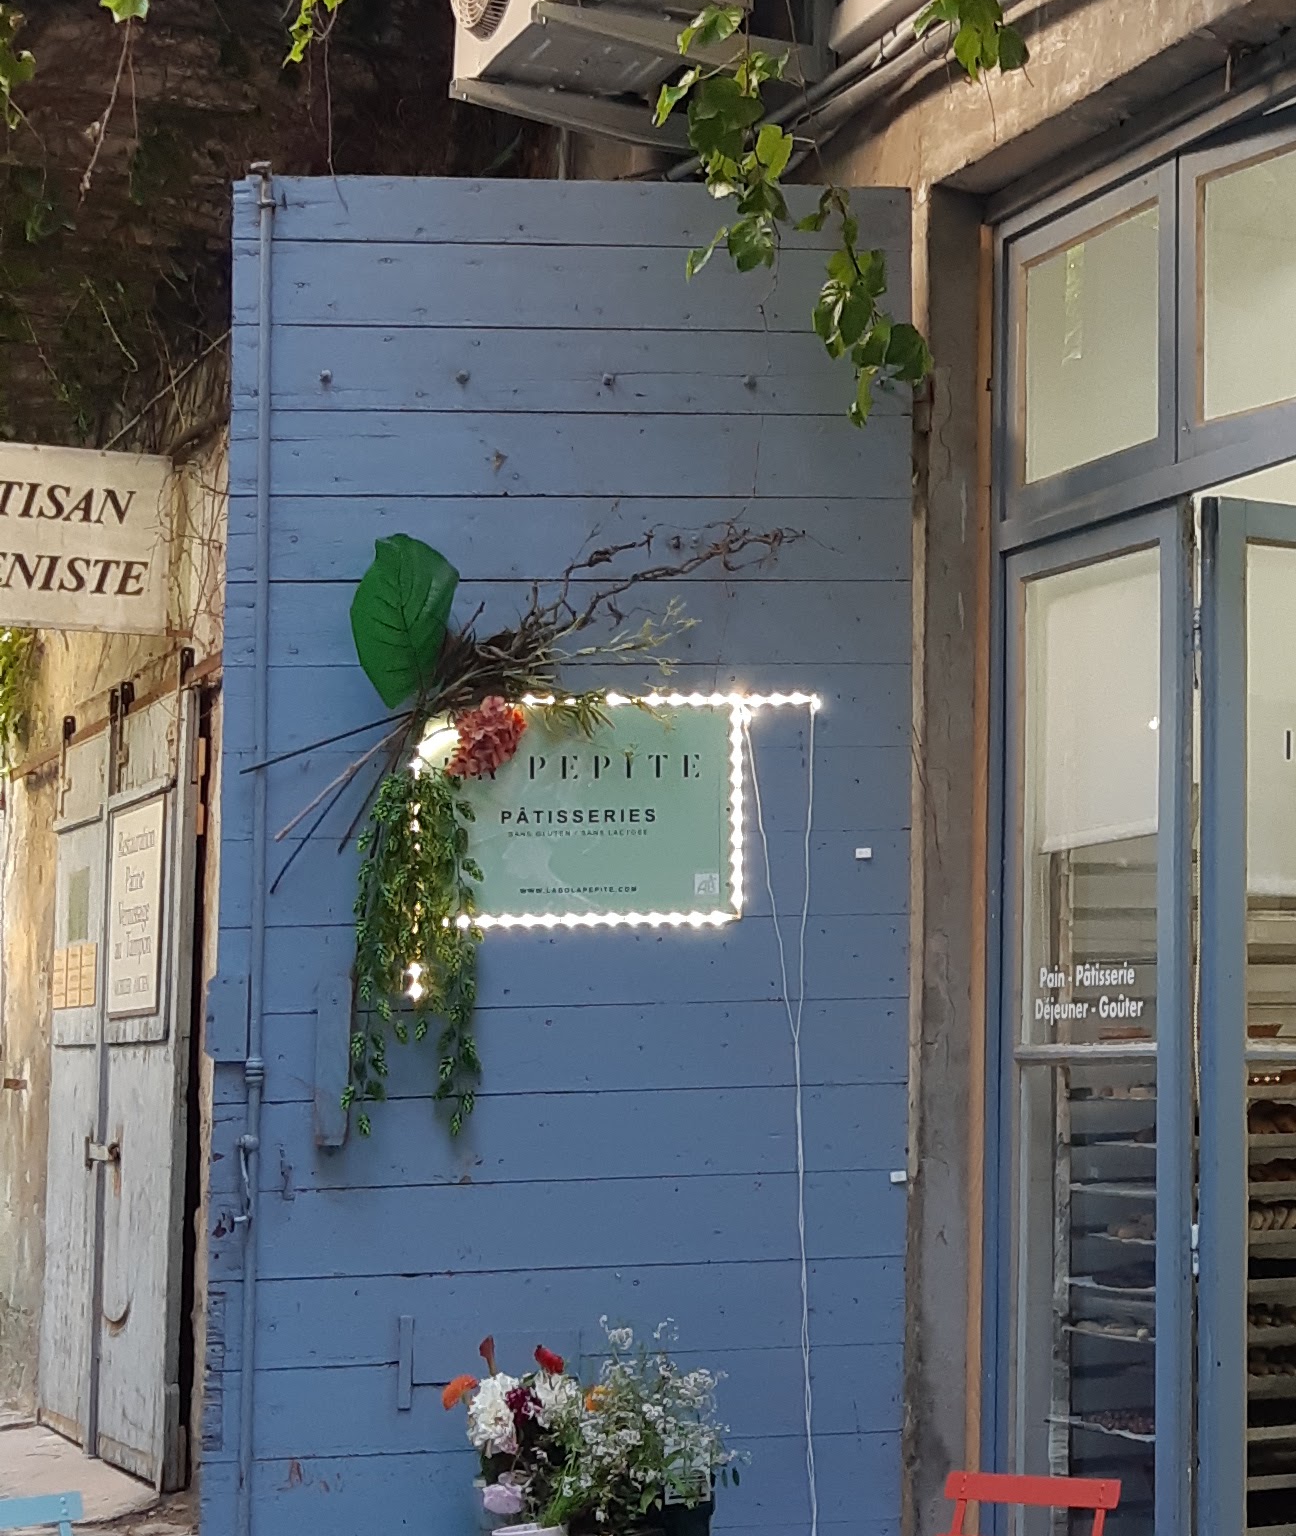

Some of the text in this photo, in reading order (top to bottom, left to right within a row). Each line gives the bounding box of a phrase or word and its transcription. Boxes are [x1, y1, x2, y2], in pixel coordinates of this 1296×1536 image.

[528, 753, 702, 781] PEPITE
[500, 806, 657, 825] PÂTISSERIES
[1039, 964, 1065, 989] Pain
[1075, 961, 1135, 987] Pâtisserie
[1034, 996, 1089, 1026] Déjeuner
[1099, 993, 1144, 1018] Goûter
